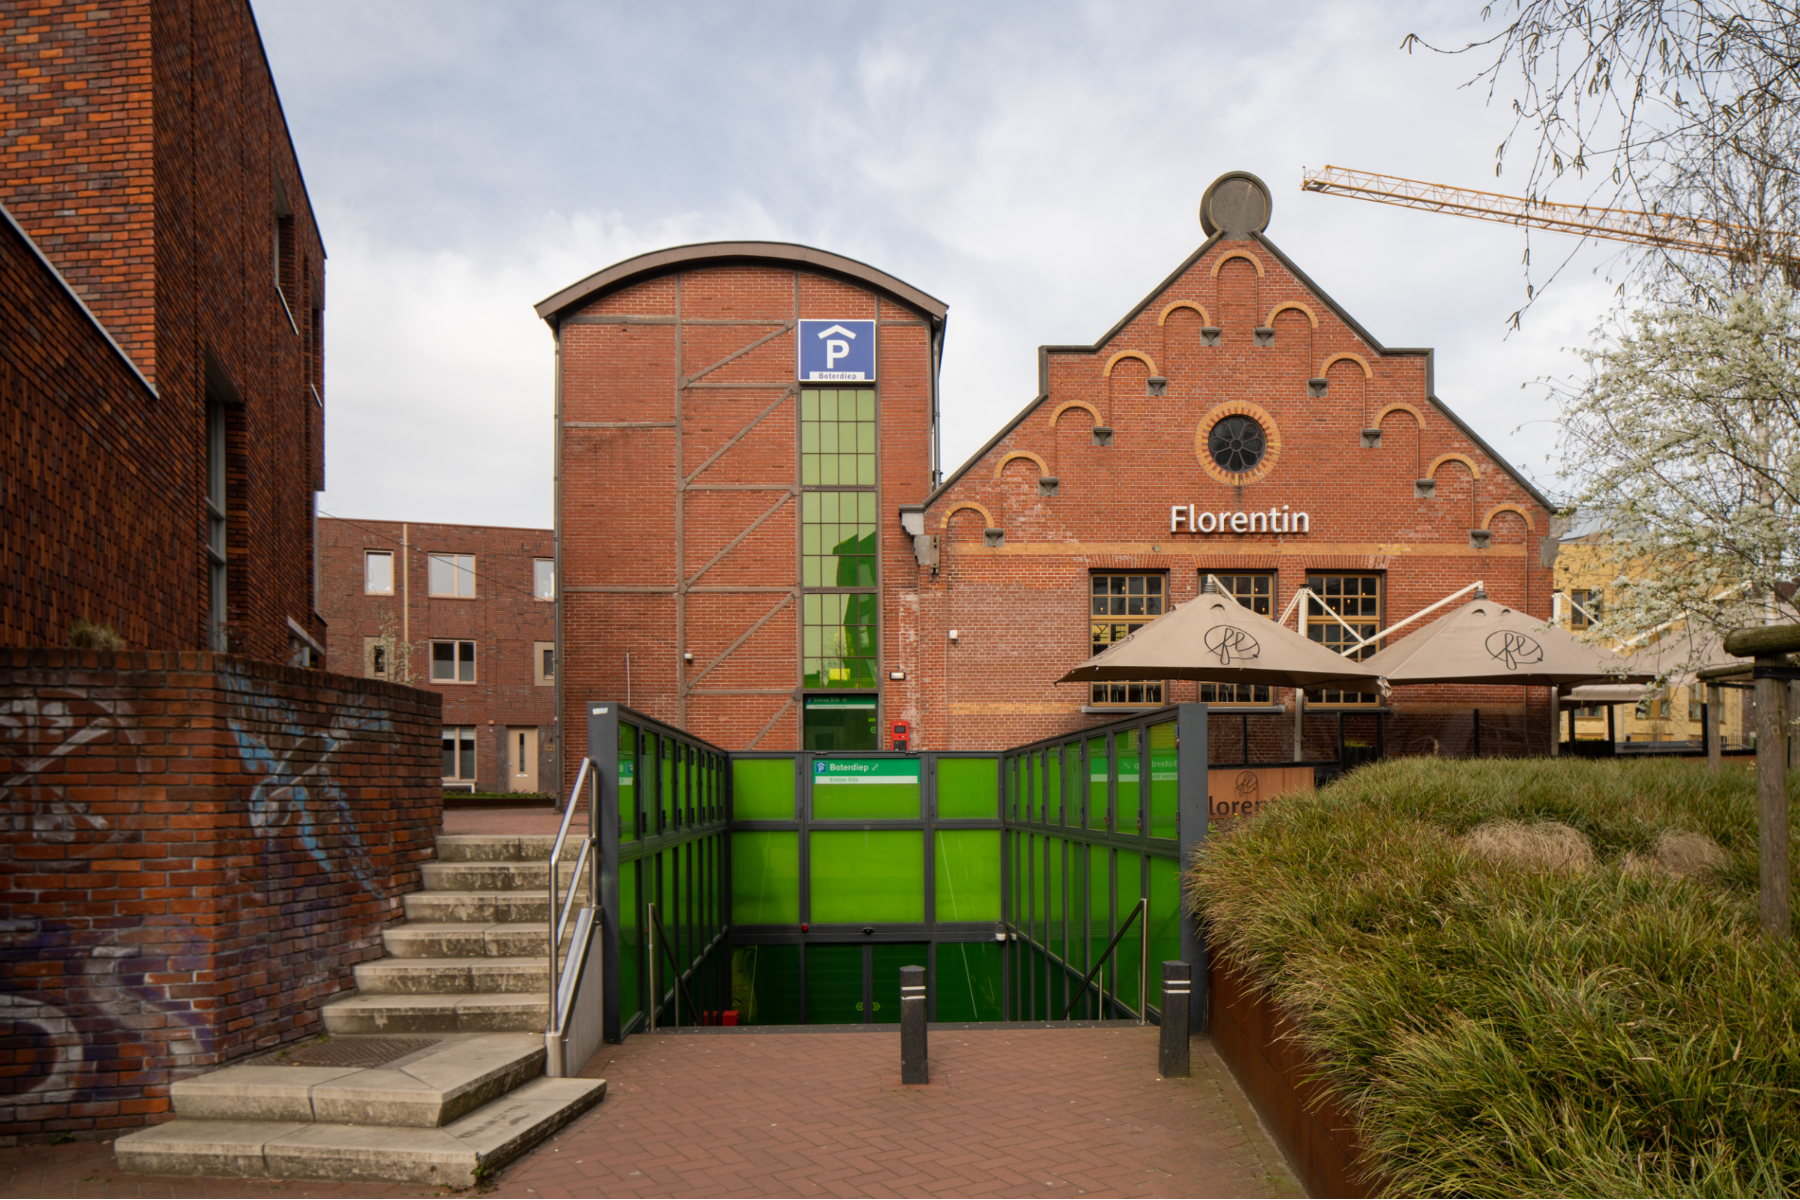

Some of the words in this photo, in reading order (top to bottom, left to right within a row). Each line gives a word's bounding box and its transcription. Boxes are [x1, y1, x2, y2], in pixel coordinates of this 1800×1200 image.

[826, 339, 850, 370] P
[818, 372, 857, 380] Boterdiep
[1170, 503, 1310, 533] Florentin
[829, 763, 869, 773] Boterdiep
